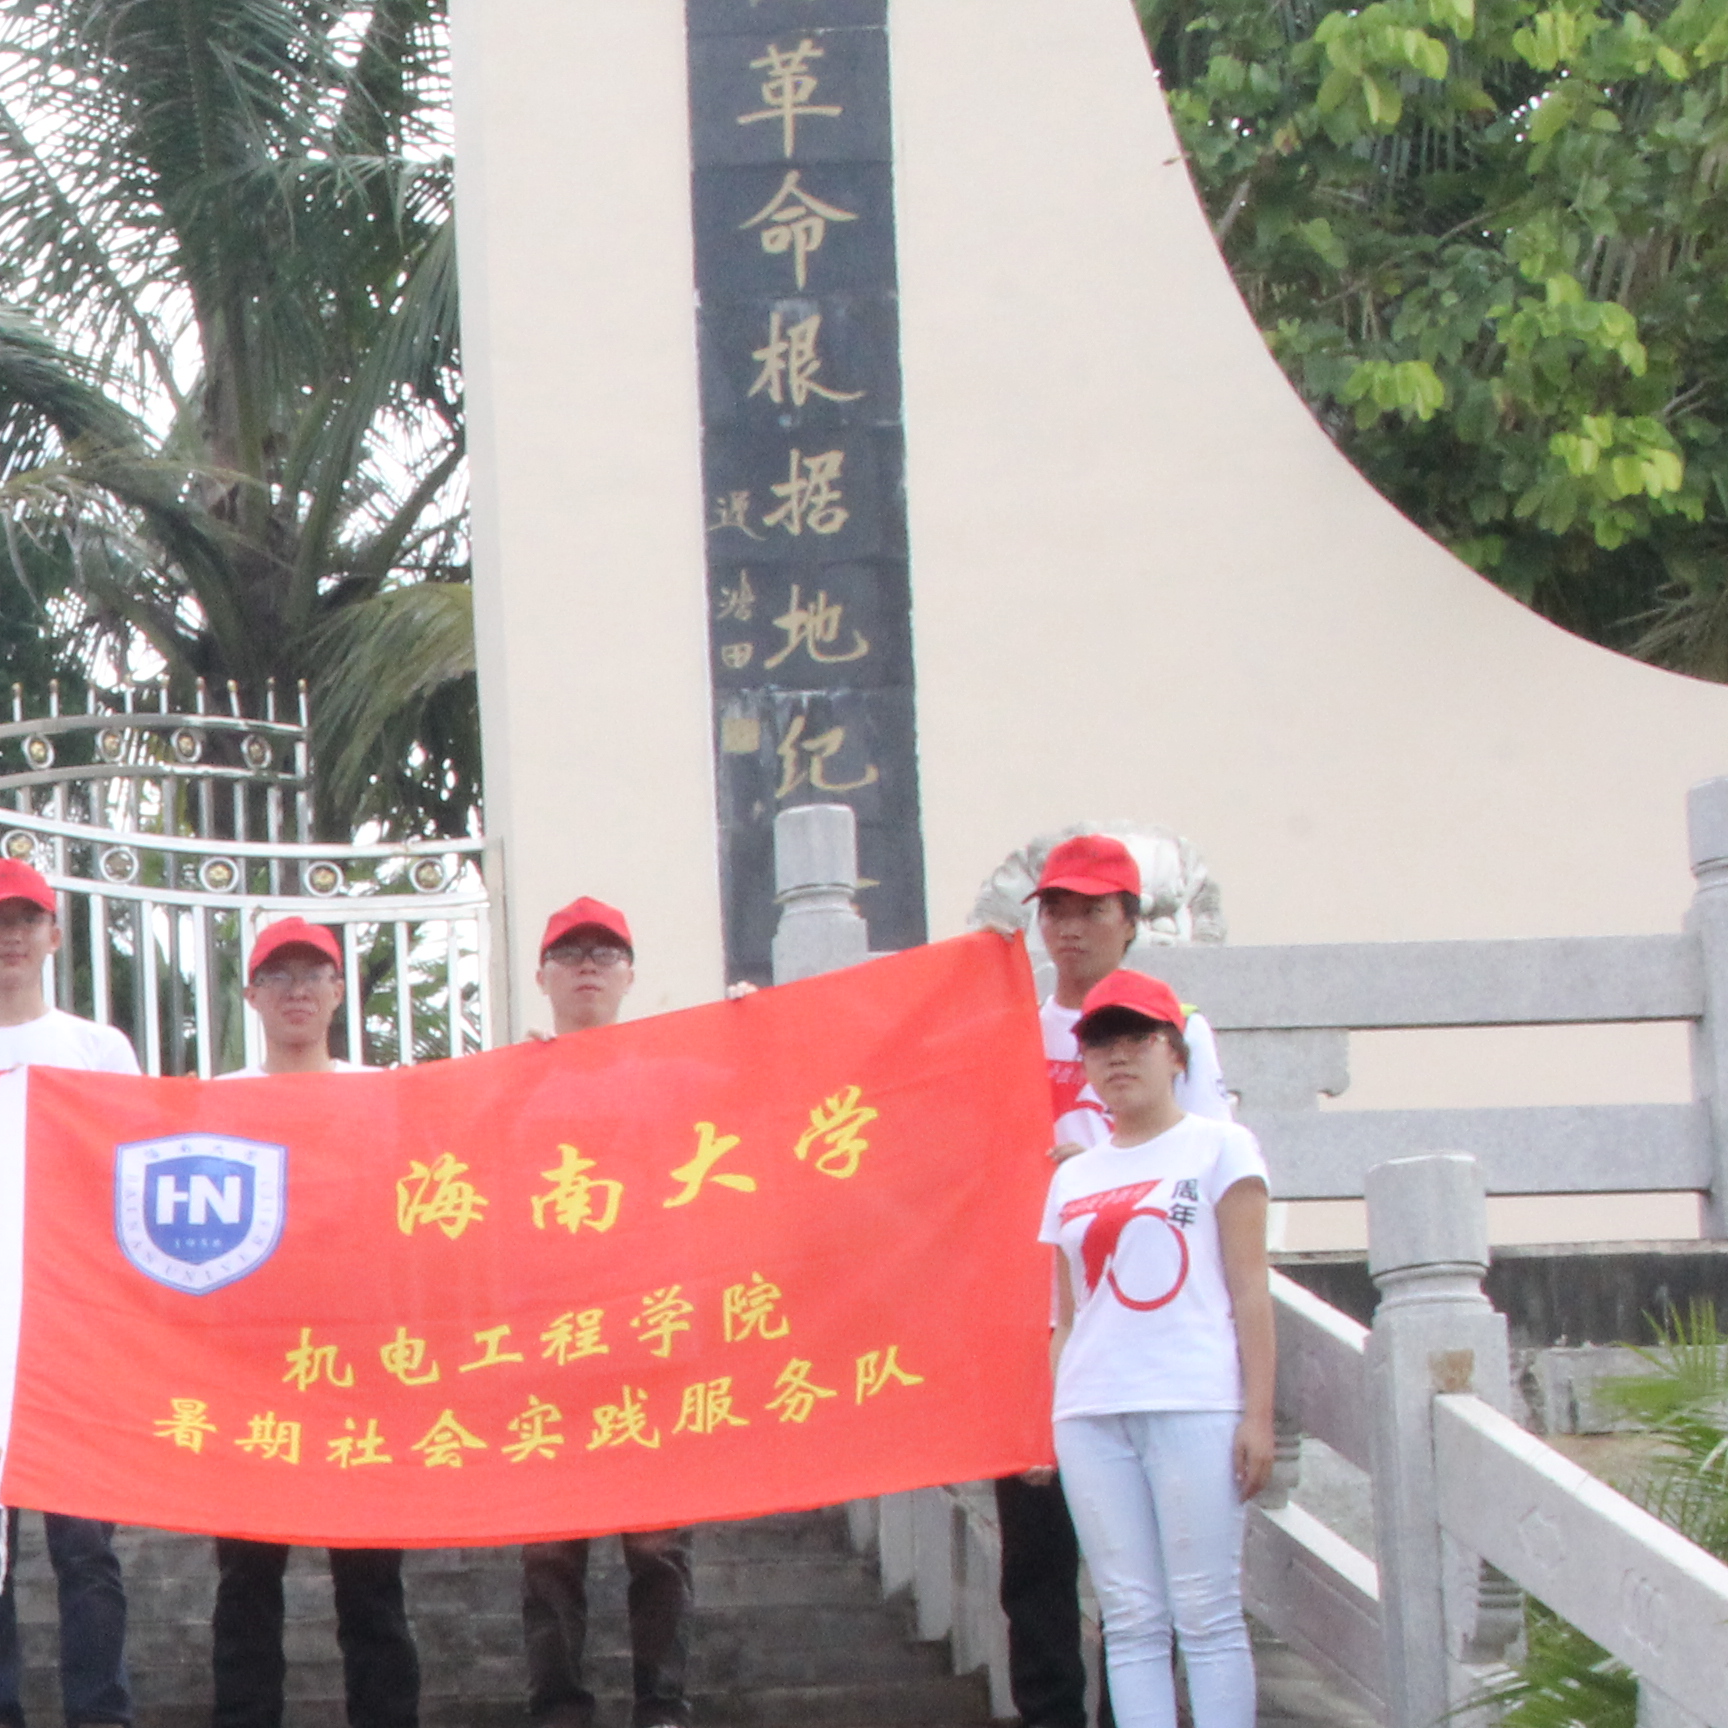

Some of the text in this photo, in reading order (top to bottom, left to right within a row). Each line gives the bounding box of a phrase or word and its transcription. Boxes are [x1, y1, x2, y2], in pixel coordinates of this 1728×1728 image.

[735, 38, 882, 918] 革命根据地纪
[156, 1174, 242, 1226] HN
[396, 1086, 879, 1239] 海南大学
[1168, 1177, 1199, 1229] 周年
[1060, 1179, 1189, 1311] 70
[281, 1271, 791, 1392] 机电工程学院
[153, 1345, 925, 1470] 暑期社会实践服务队
